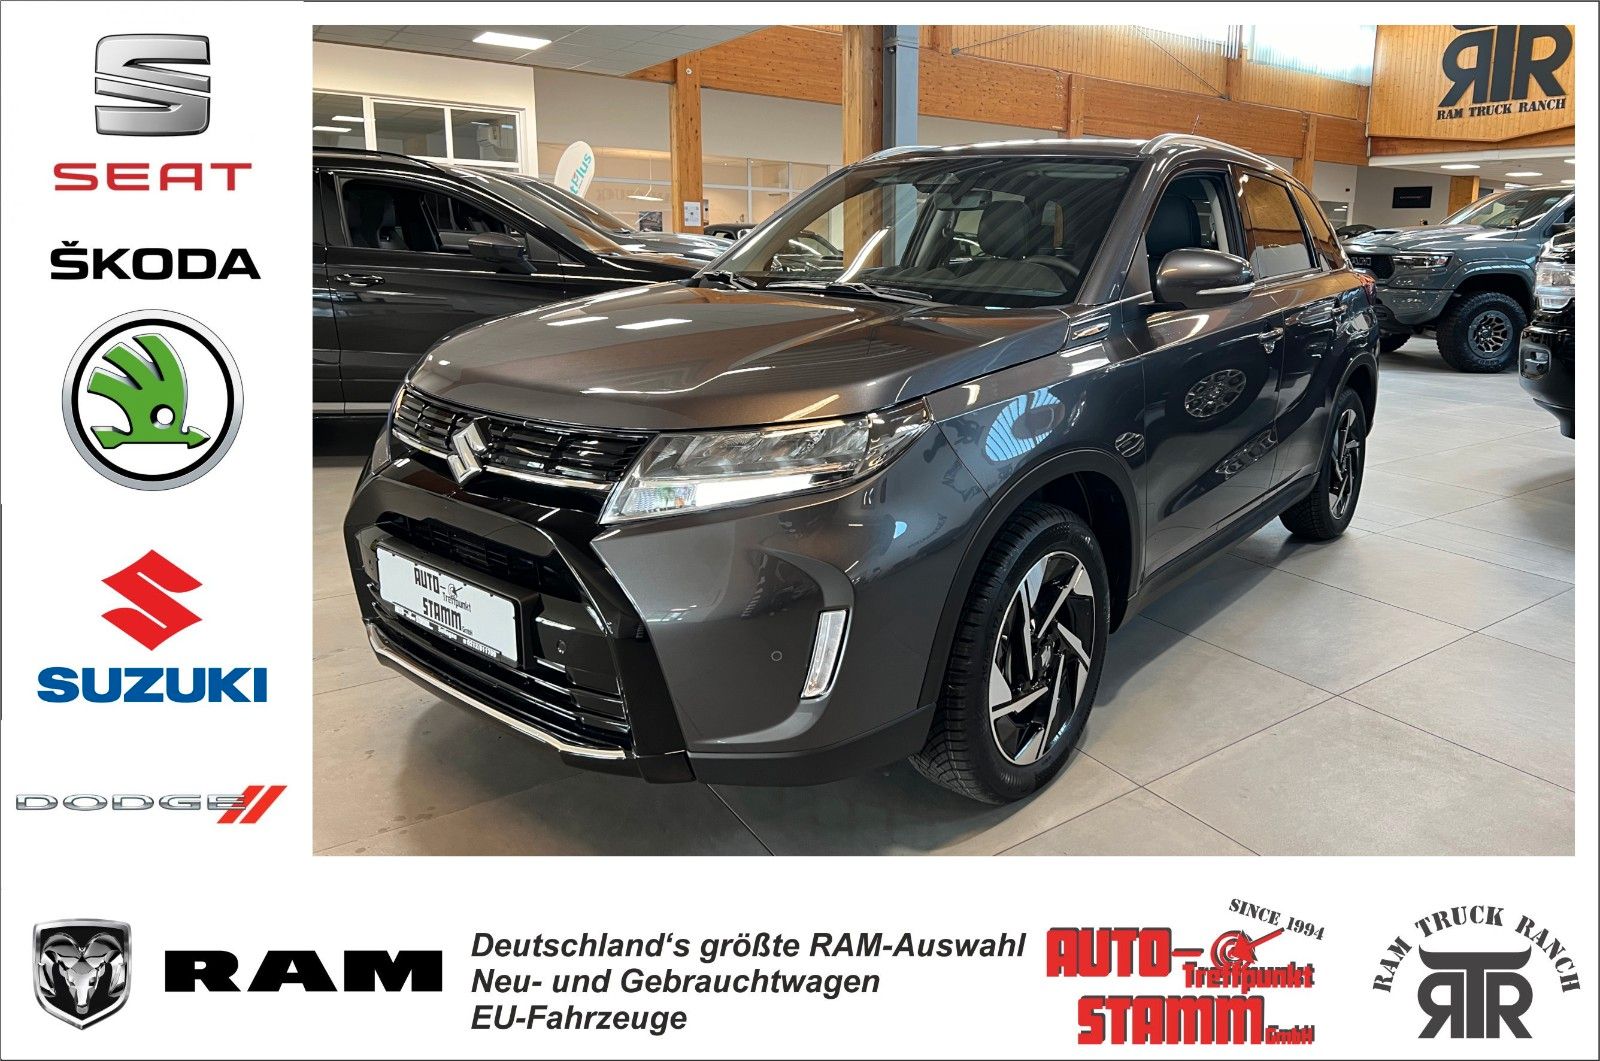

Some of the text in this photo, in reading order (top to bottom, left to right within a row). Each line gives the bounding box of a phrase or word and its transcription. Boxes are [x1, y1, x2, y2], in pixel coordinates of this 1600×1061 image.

[1437, 98, 1566, 120] RAM TRUCK RANCH
[423, 597, 462, 631] STAMM
